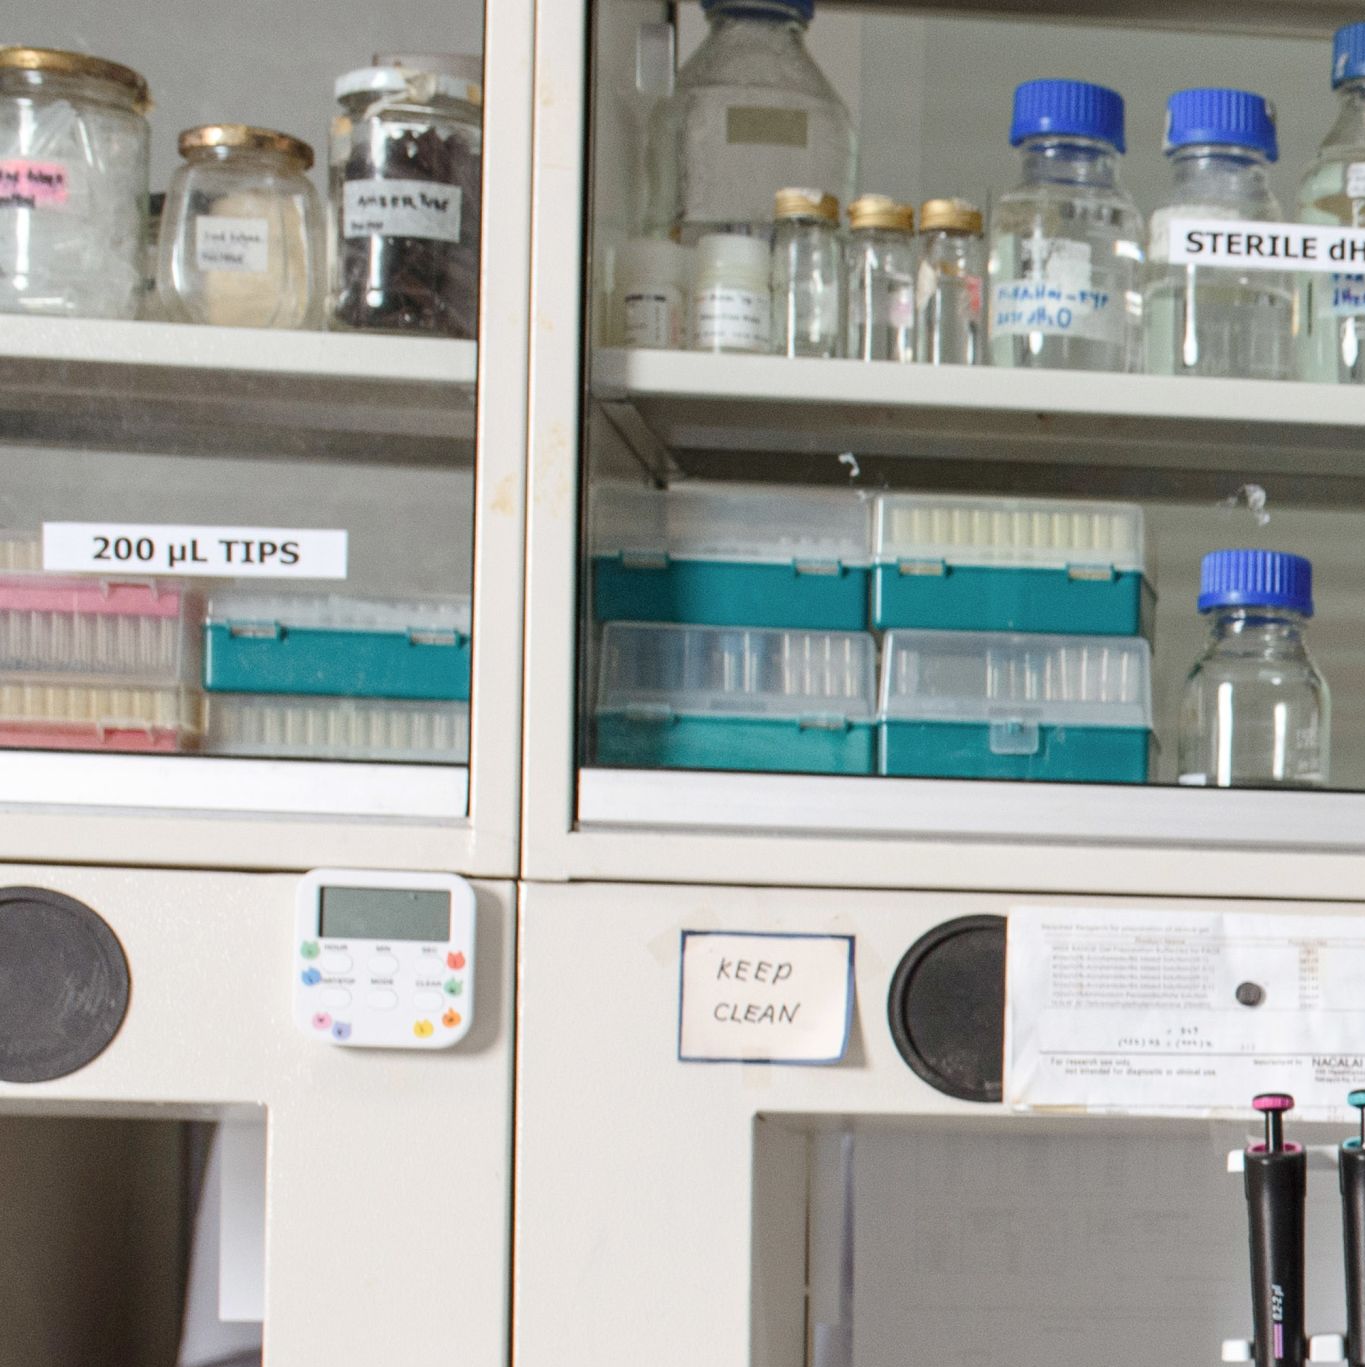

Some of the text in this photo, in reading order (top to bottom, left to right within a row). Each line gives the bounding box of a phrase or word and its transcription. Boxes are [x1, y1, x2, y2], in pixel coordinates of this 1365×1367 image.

[1185, 230, 1318, 260] STERILE
[91, 536, 301, 568] 200 µL TIPS
[716, 956, 794, 987] KEEP
[713, 1000, 802, 1026] CLEAN
[1311, 1057, 1364, 1069] NACALAI
